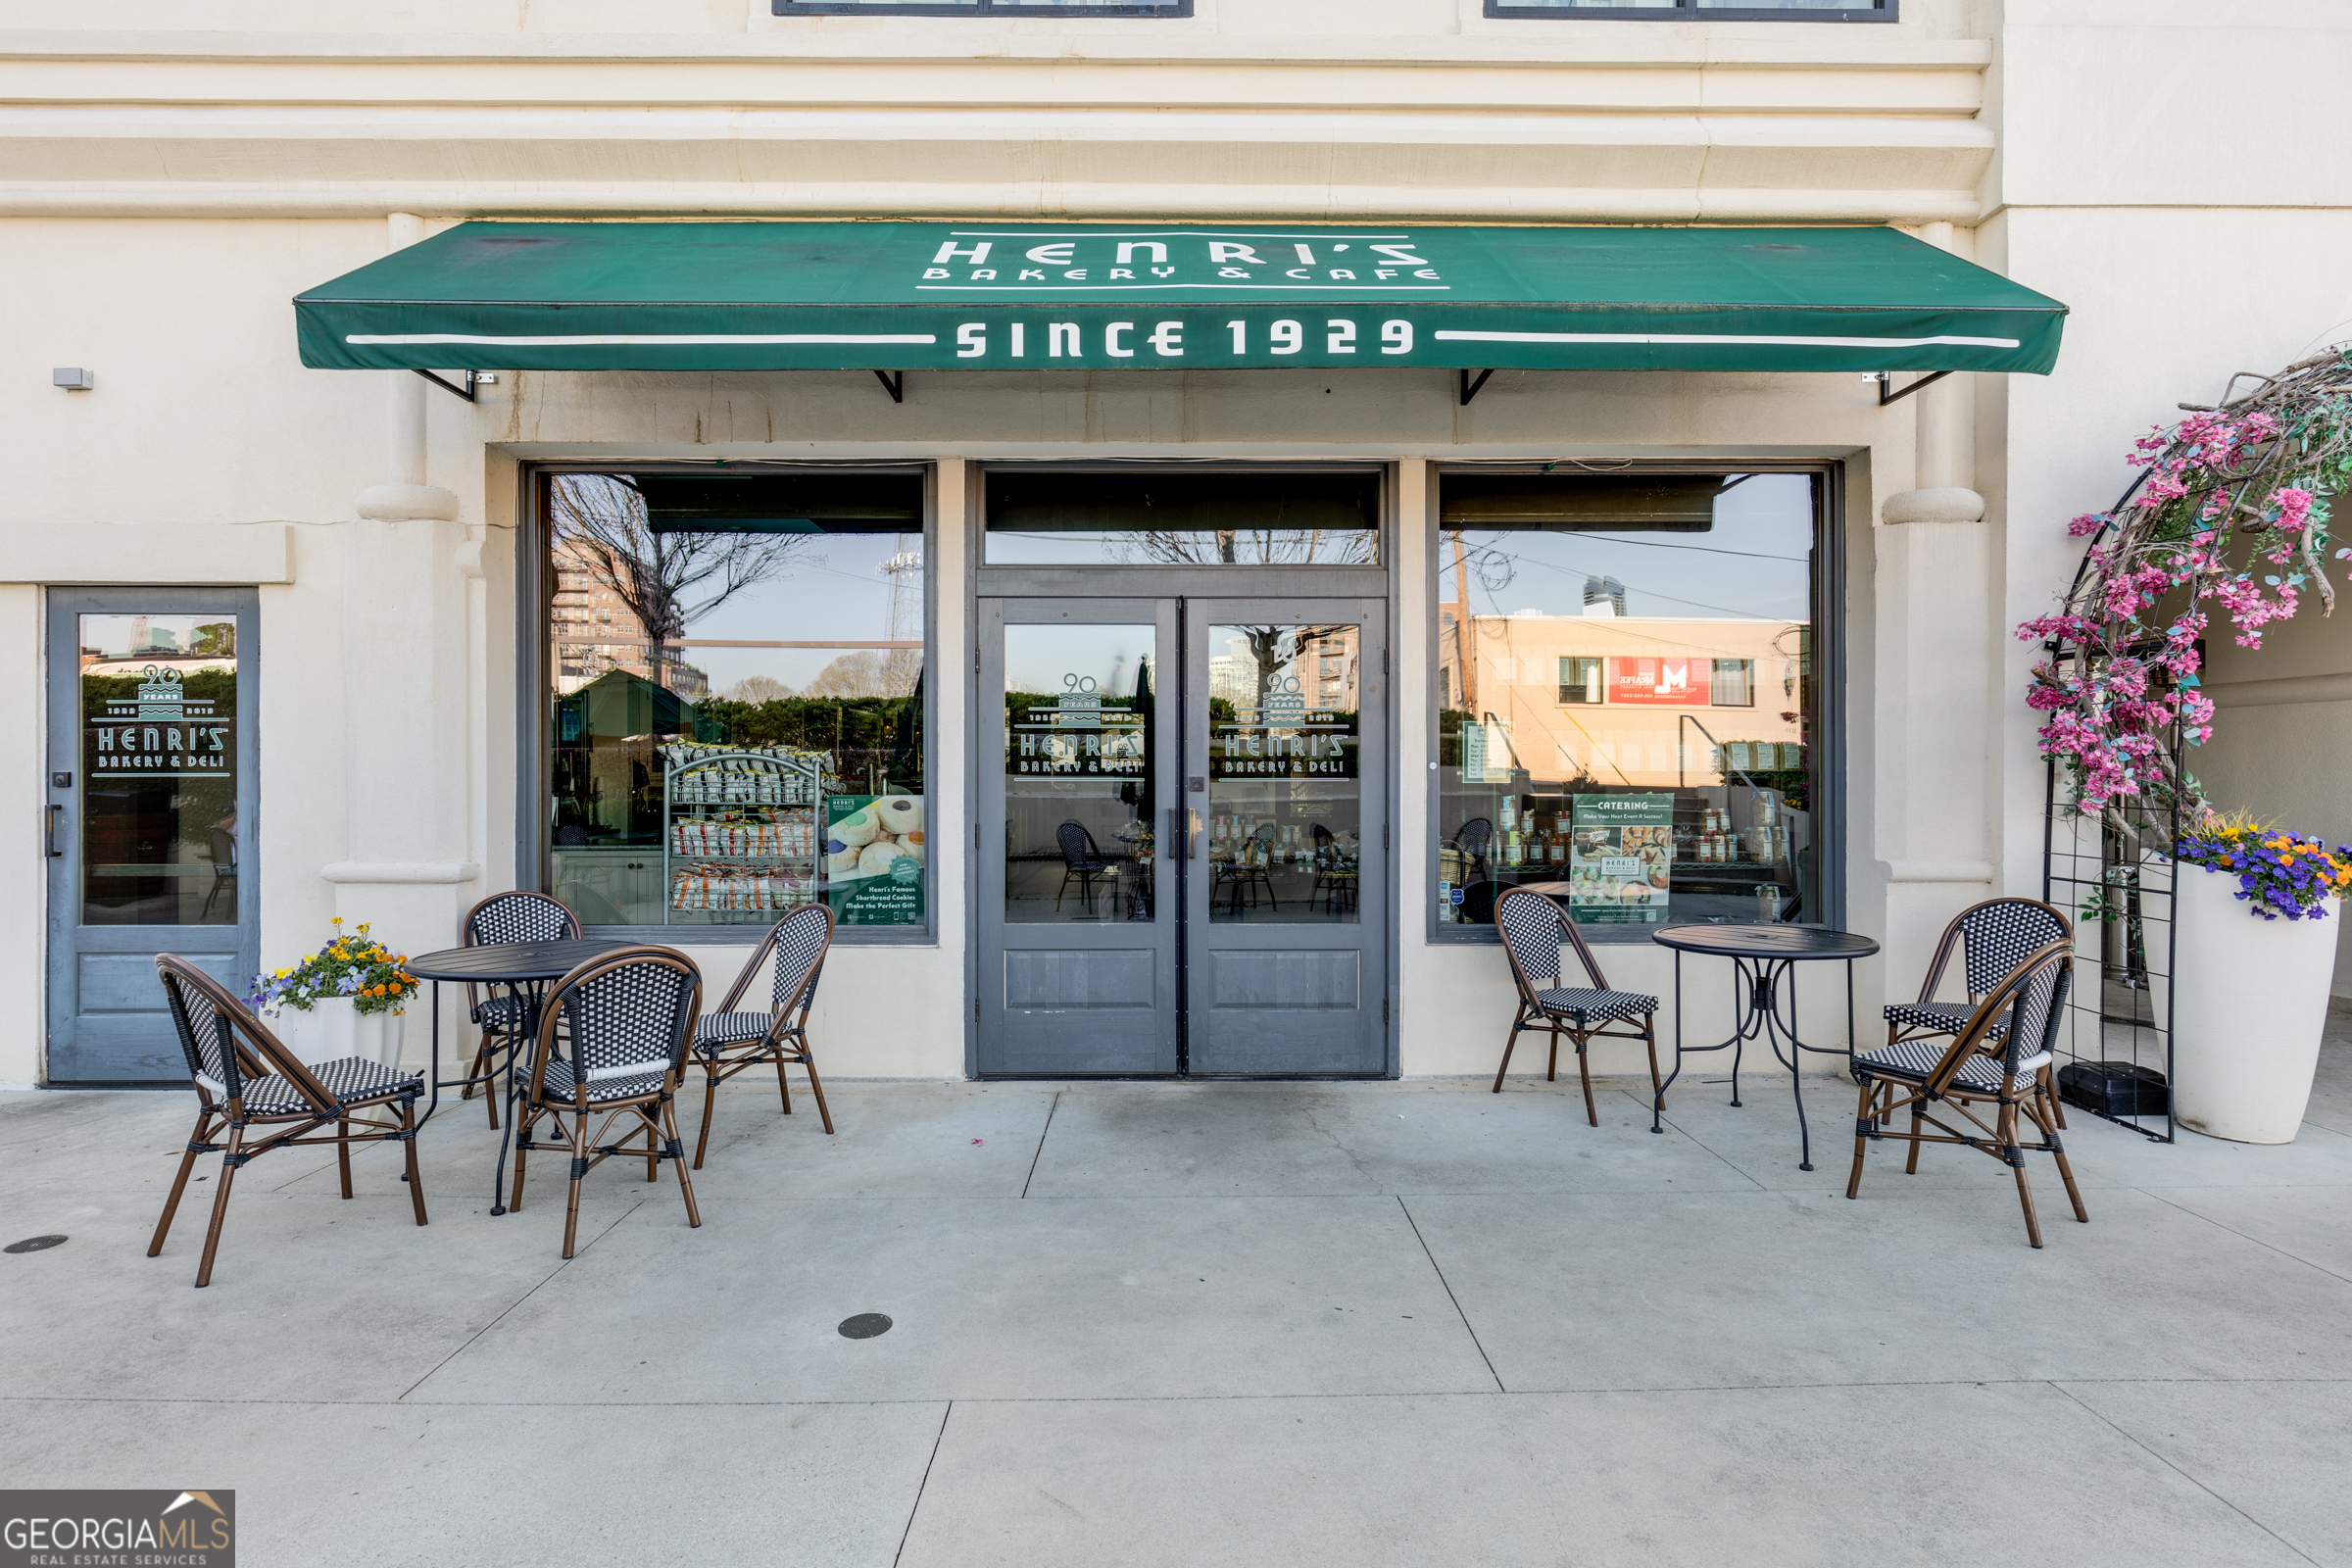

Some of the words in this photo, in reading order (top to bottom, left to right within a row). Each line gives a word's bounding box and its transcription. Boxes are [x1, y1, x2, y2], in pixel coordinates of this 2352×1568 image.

[932, 241, 1429, 266] HENRI'S
[922, 267, 1175, 280] BAKERY
[1218, 267, 1251, 279] &
[1286, 269, 1441, 280] CAFE
[956, 320, 1184, 358] SINCE
[1226, 318, 1414, 355] 1929
[143, 664, 178, 685] 90
[1063, 672, 1097, 693] 90
[1267, 672, 1300, 693] 90
[98, 727, 223, 751] HENRI'S
[1020, 734, 1138, 757] HENRI'S
[1225, 734, 1344, 757] HENRI'S
[98, 756, 163, 767] BAKERY
[170, 756, 180, 767] &
[187, 756, 223, 767] DELI
[1020, 760, 1081, 772] BAKERY
[1089, 760, 1099, 772] &
[1104, 760, 1139, 772] DELI
[1225, 760, 1286, 772] BAKERY
[1293, 760, 1302, 772] &
[1309, 760, 1344, 772] DELI
[1597, 802, 1649, 810] CATERING
